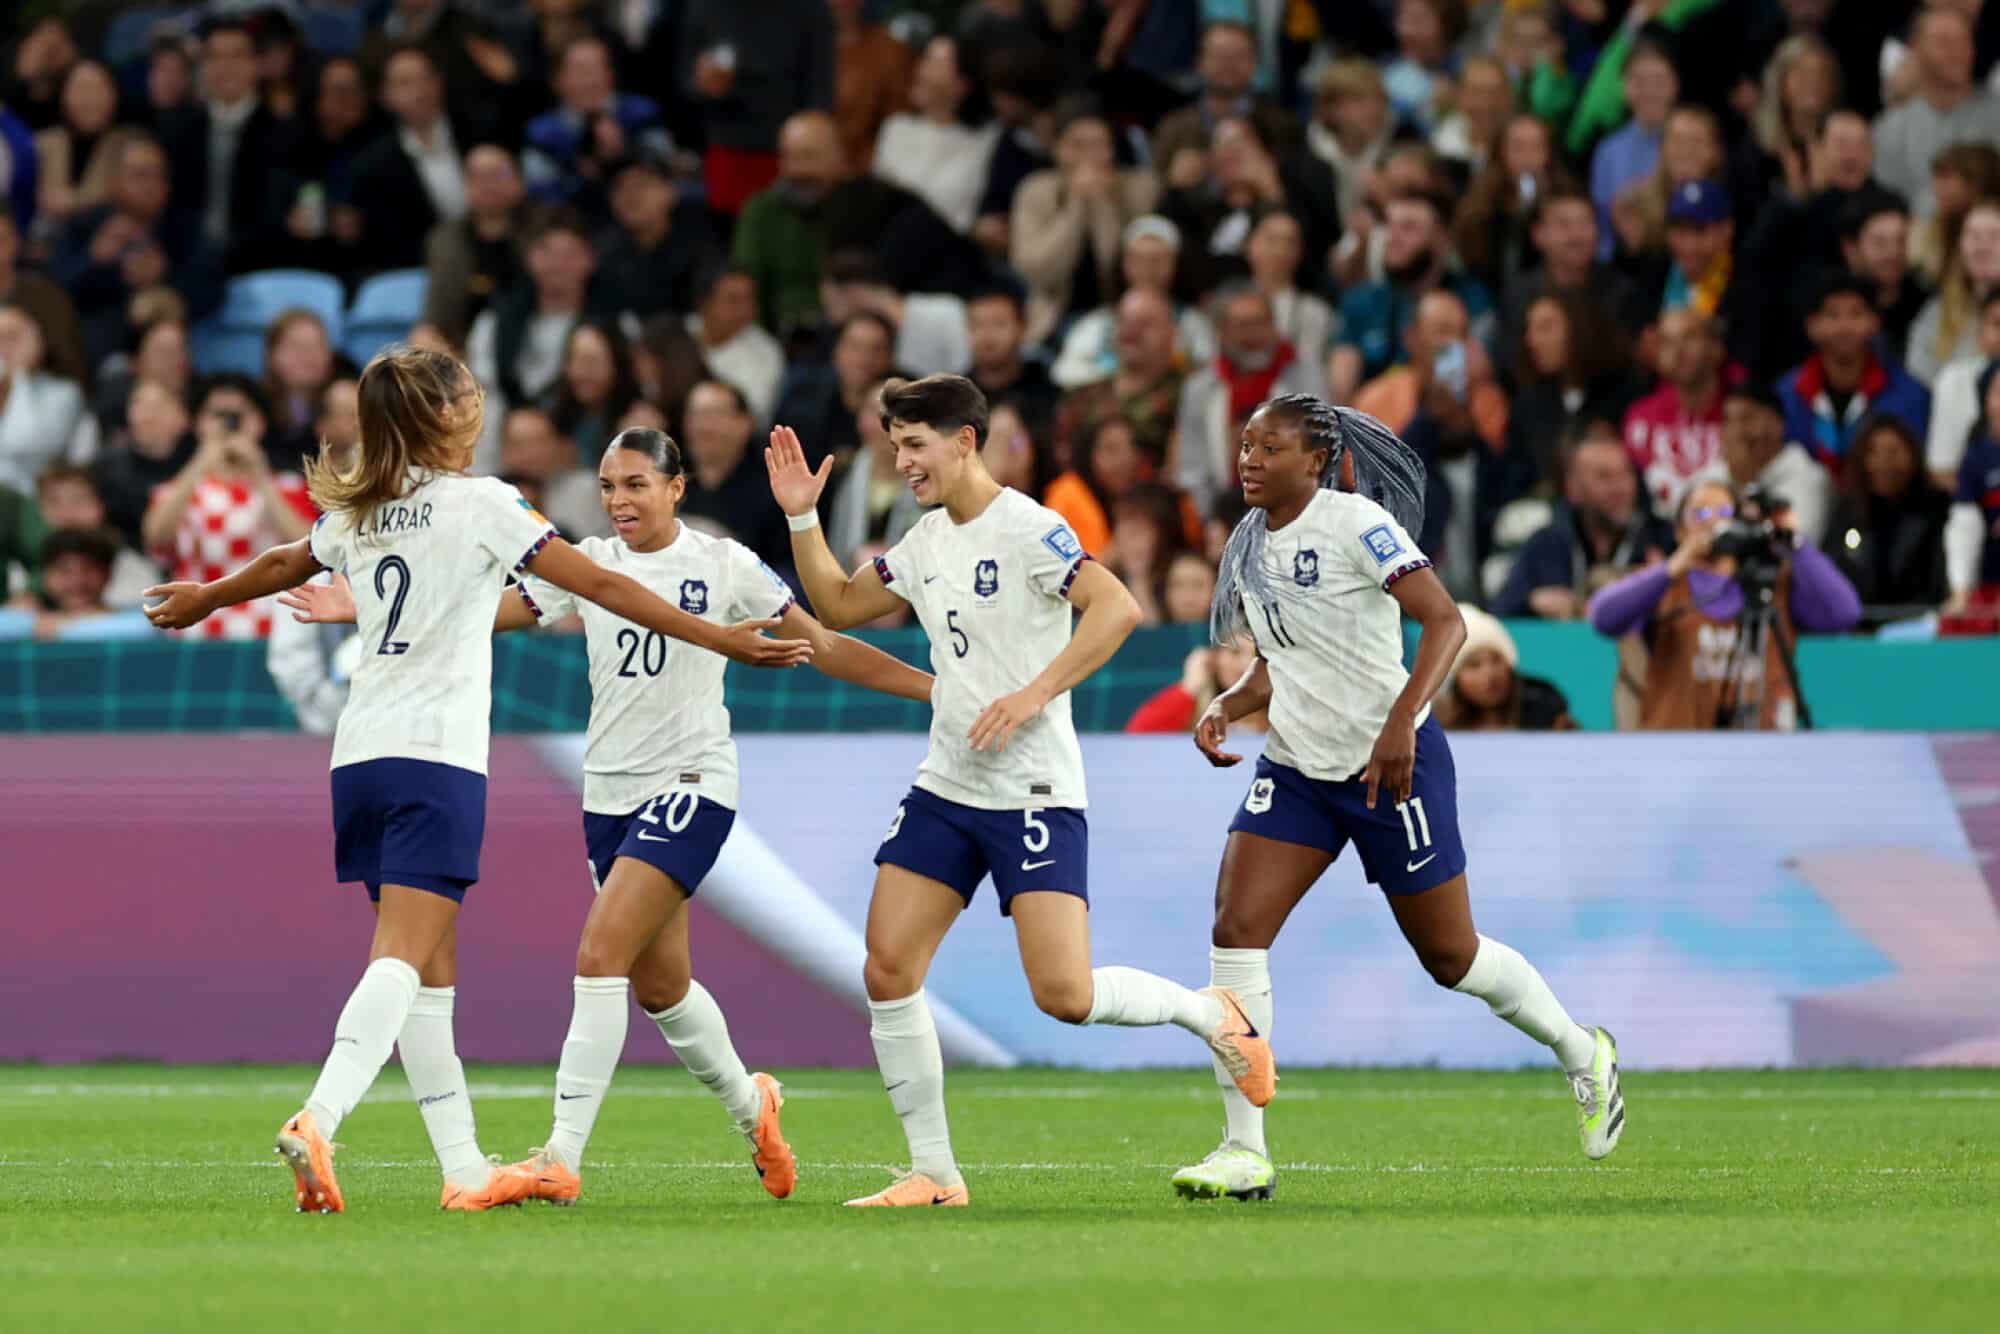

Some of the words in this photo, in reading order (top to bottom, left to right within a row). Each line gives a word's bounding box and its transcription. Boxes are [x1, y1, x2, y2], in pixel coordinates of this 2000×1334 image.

[374, 554, 411, 655] 2
[1262, 601, 1296, 648] 11
[617, 628, 667, 678] 20
[947, 610, 969, 658] 5
[637, 791, 699, 833] 20
[1023, 808, 1050, 853] 5
[1395, 796, 1432, 851] 11
